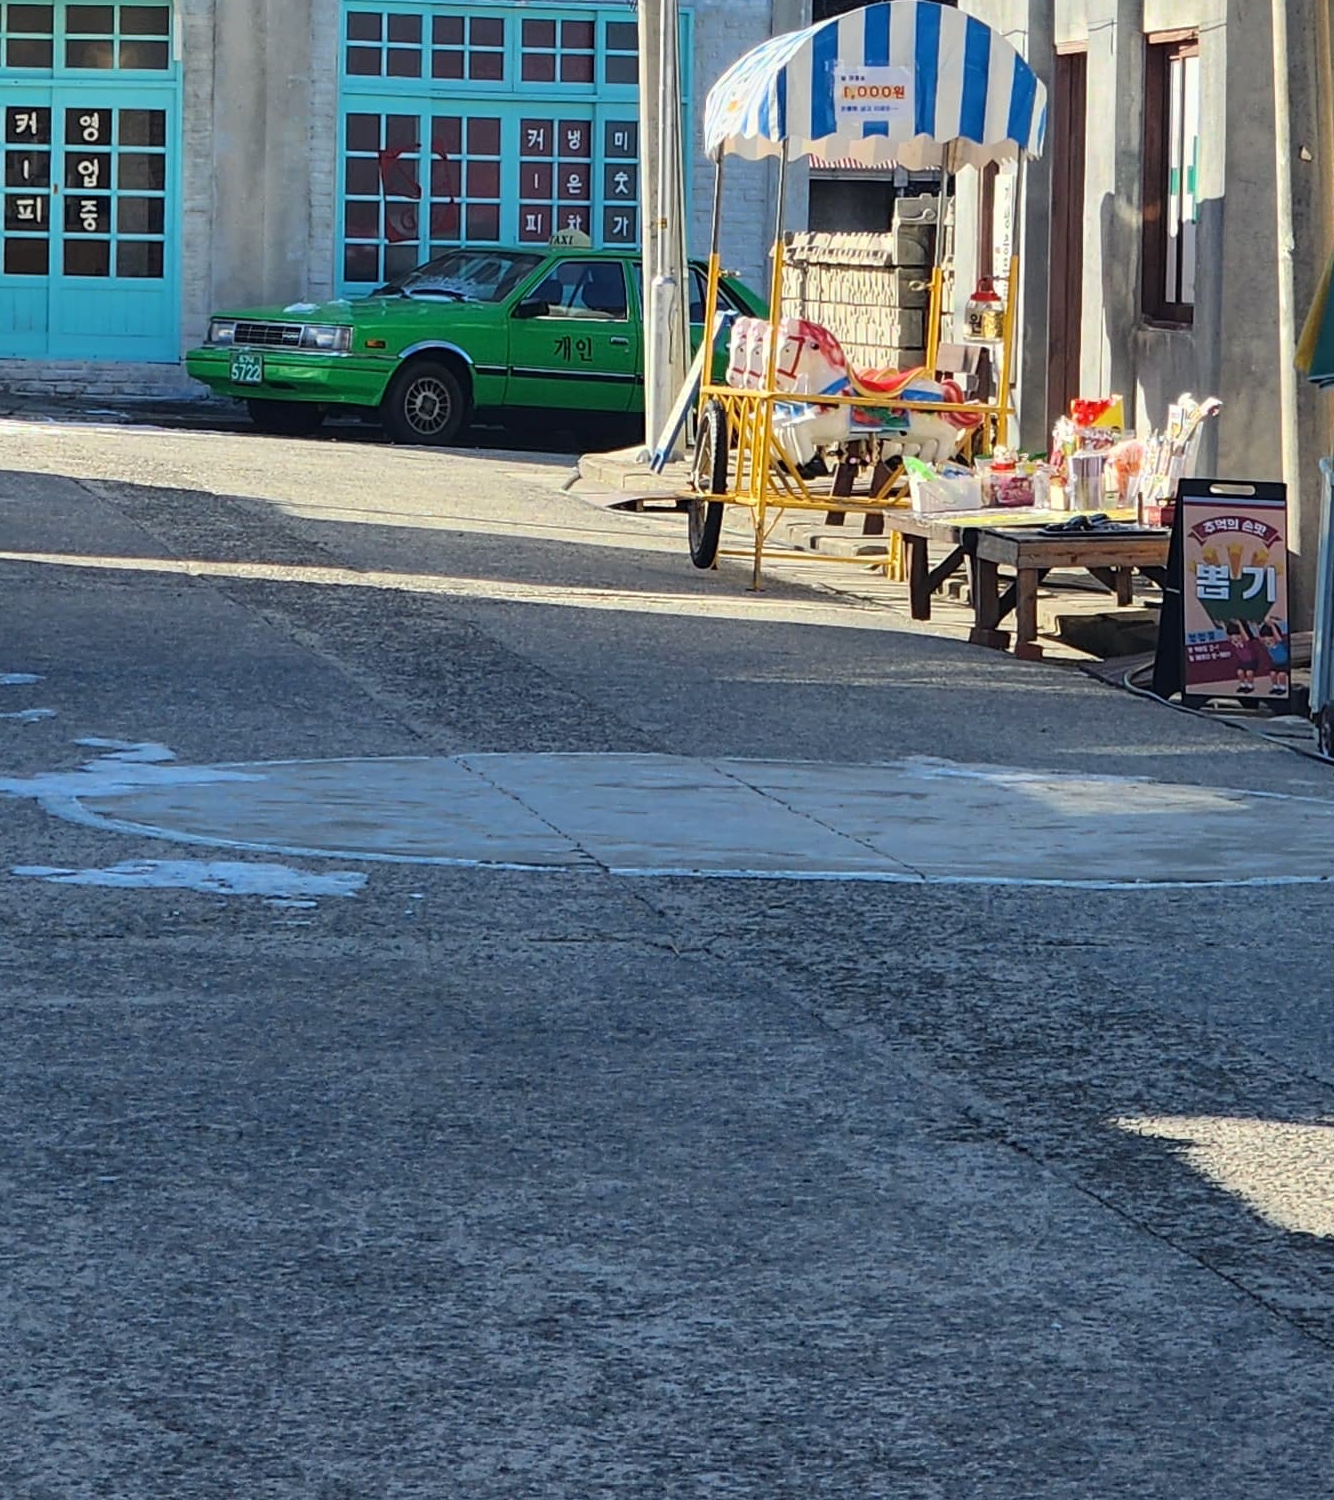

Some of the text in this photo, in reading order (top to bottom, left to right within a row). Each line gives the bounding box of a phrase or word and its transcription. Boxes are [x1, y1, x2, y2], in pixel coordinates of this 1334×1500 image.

[77, 111, 100, 232] 영업중
[553, 336, 593, 363] 개인
[231, 363, 261, 381] 5722
[1202, 518, 1239, 533] 추억의
[1195, 563, 1277, 603] 뽑기
